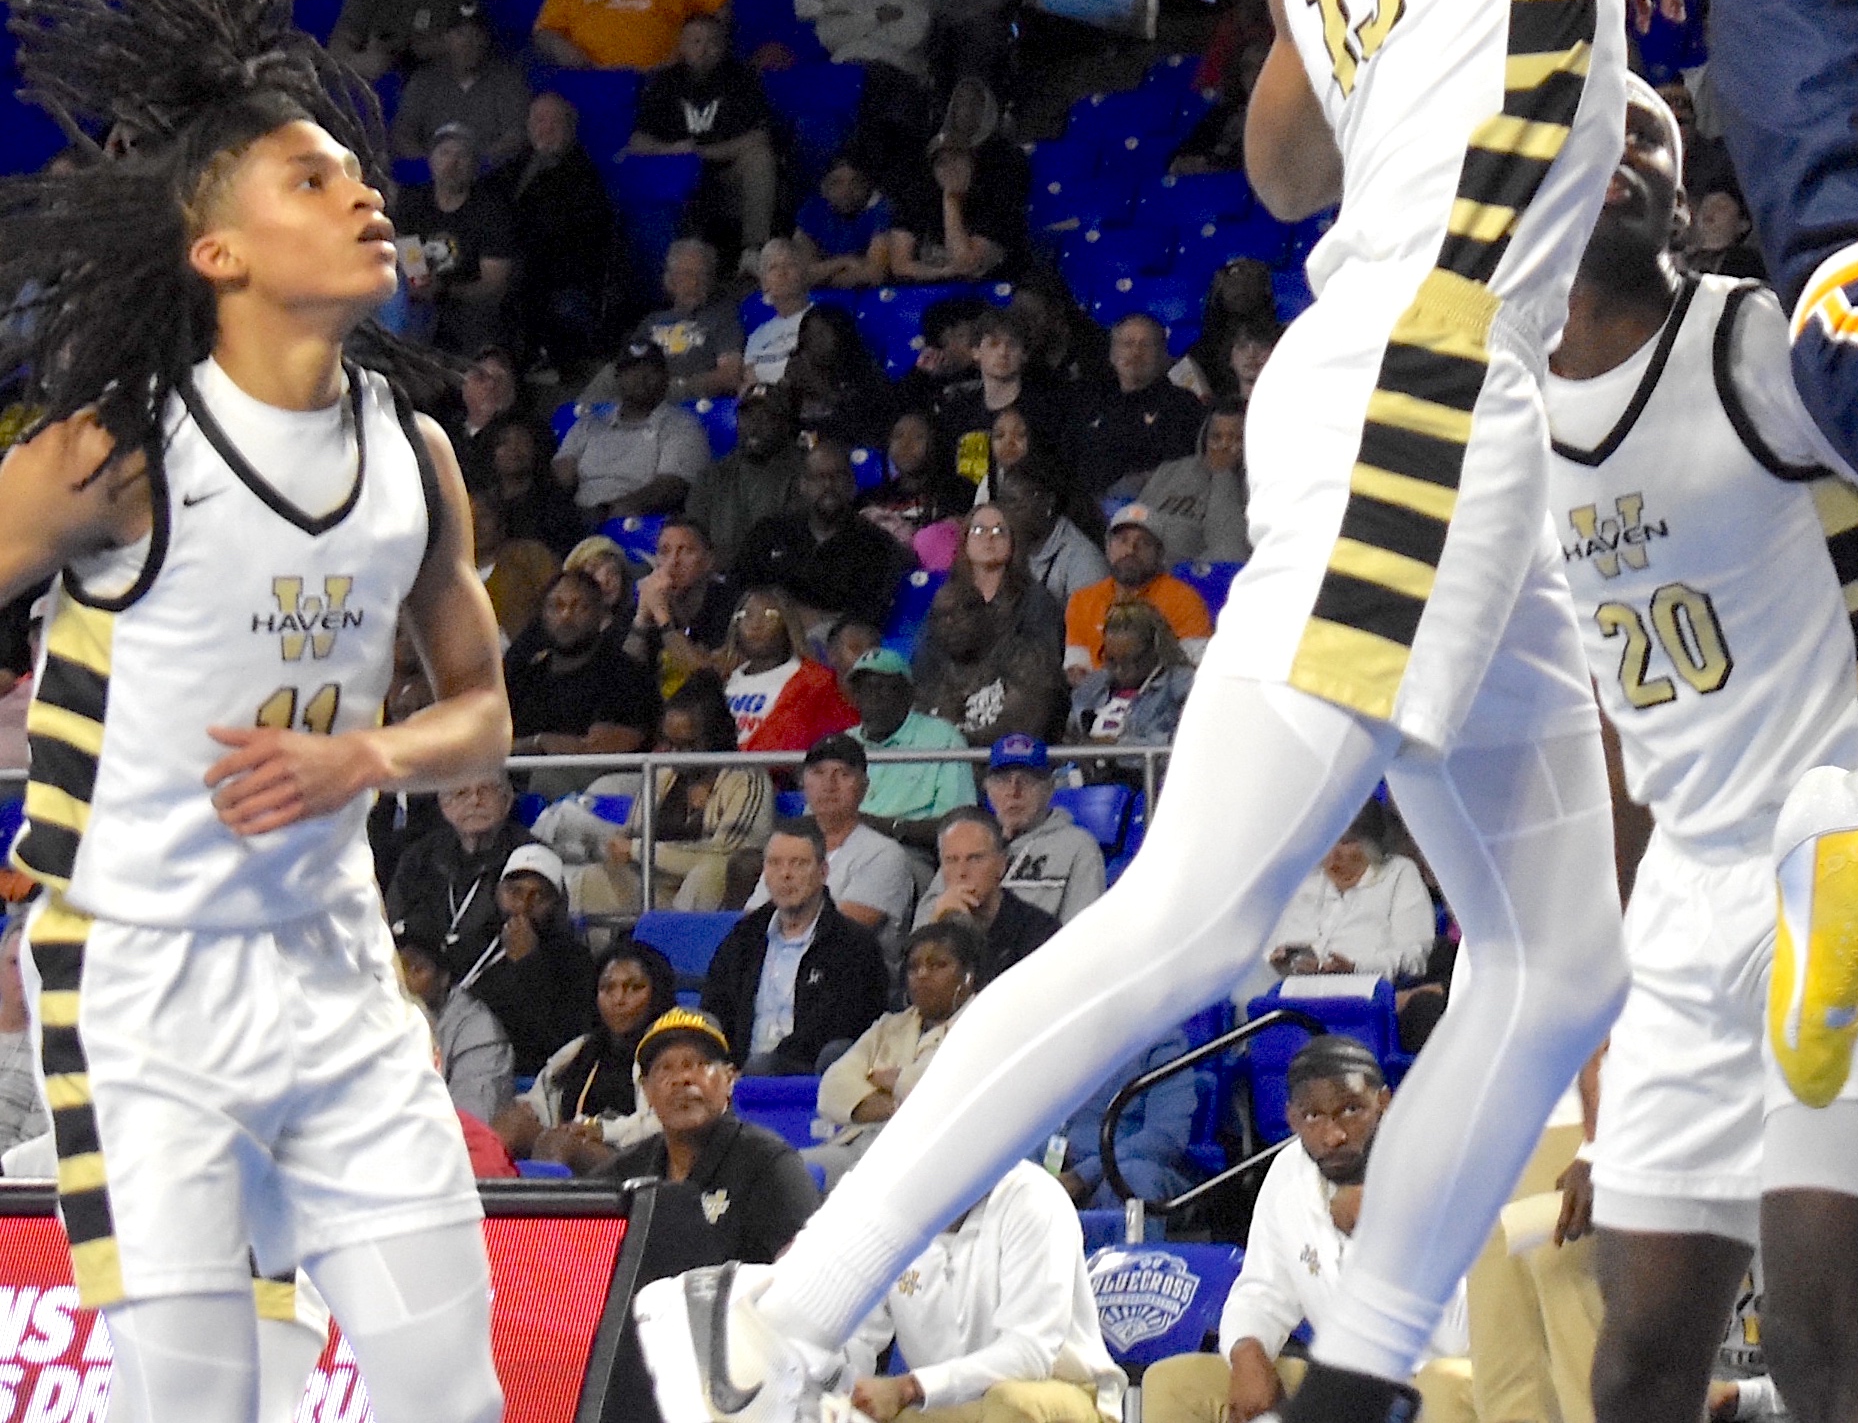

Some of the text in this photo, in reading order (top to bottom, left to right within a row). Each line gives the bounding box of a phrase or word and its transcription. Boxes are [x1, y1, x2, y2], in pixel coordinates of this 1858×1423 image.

[1564, 518, 1668, 562] HAVEN
[252, 609, 363, 633] HAVEN
[1595, 583, 1733, 709] 20
